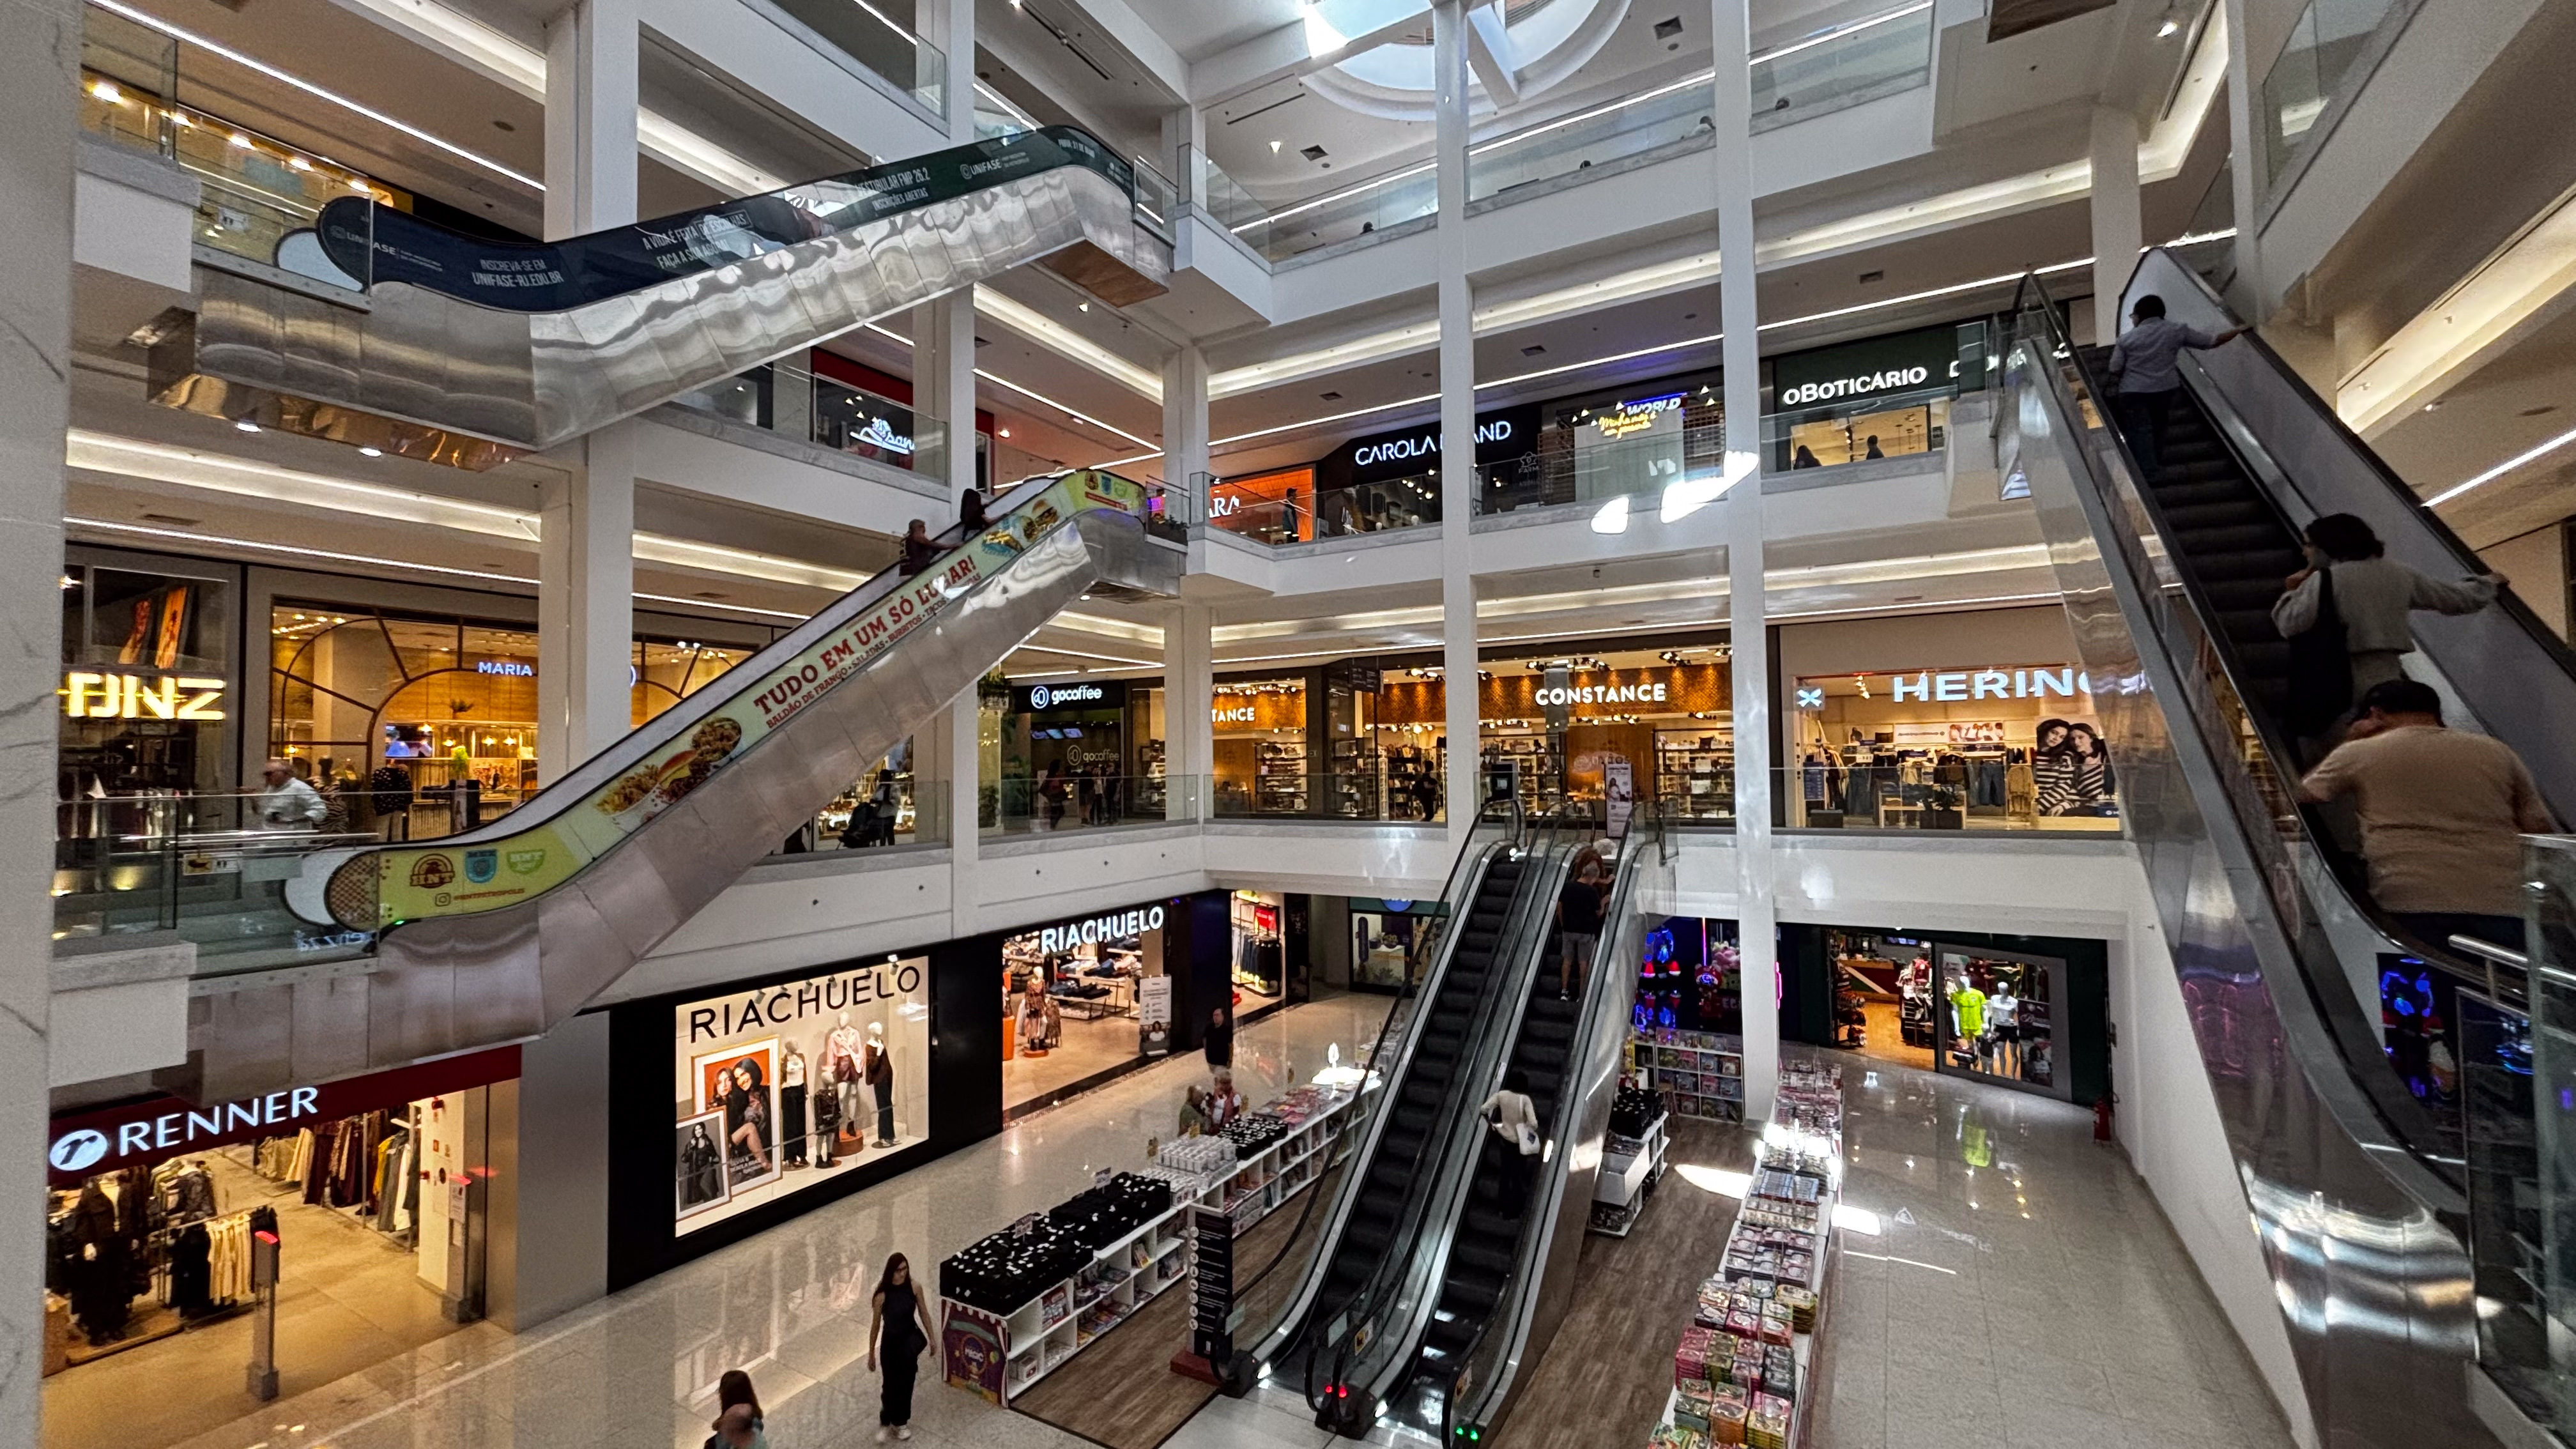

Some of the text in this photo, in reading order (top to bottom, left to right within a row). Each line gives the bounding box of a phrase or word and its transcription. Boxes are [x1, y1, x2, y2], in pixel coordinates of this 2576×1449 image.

[970, 158, 1002, 176] UNIFASE
[854, 167, 931, 197] VESTIBULAR FMP 26.2
[904, 187, 928, 203] ABERTAS
[347, 231, 397, 256] UNASE
[642, 237, 653, 250] A
[649, 231, 671, 249] VIDA
[674, 226, 699, 242] FEITA
[480, 259, 548, 272] INSCREVA-SE EM
[657, 252, 680, 269] FAÇA
[678, 250, 689, 263] A
[686, 246, 703, 261] SUA
[471, 271, 564, 287] UNIFASE-RJ.EDU.BR
[1627, 397, 1681, 416] WORLD
[1355, 436, 1436, 465] CAROLA
[754, 664, 818, 714] TUDO
[820, 638, 855, 671] EM
[854, 615, 888, 647] UM
[889, 595, 914, 625] SÓ
[915, 555, 976, 606] LUAR!
[478, 661, 533, 677] MARIA
[766, 700, 801, 728] BALDÃO
[801, 691, 815, 703] DE
[813, 667, 848, 696] FRANGO
[851, 640, 885, 668] SALADAS
[887, 614, 923, 643] BURRITOS
[1052, 686, 1102, 705] gocoffee
[1535, 683, 1666, 705] CONSTANCE
[1211, 707, 1255, 722] TANCE
[1083, 749, 1120, 763] gocoffee
[1041, 906, 1163, 955] RIACHUELO
[691, 966, 920, 1043] RIACHUELO
[119, 1087, 318, 1156] RENNER
